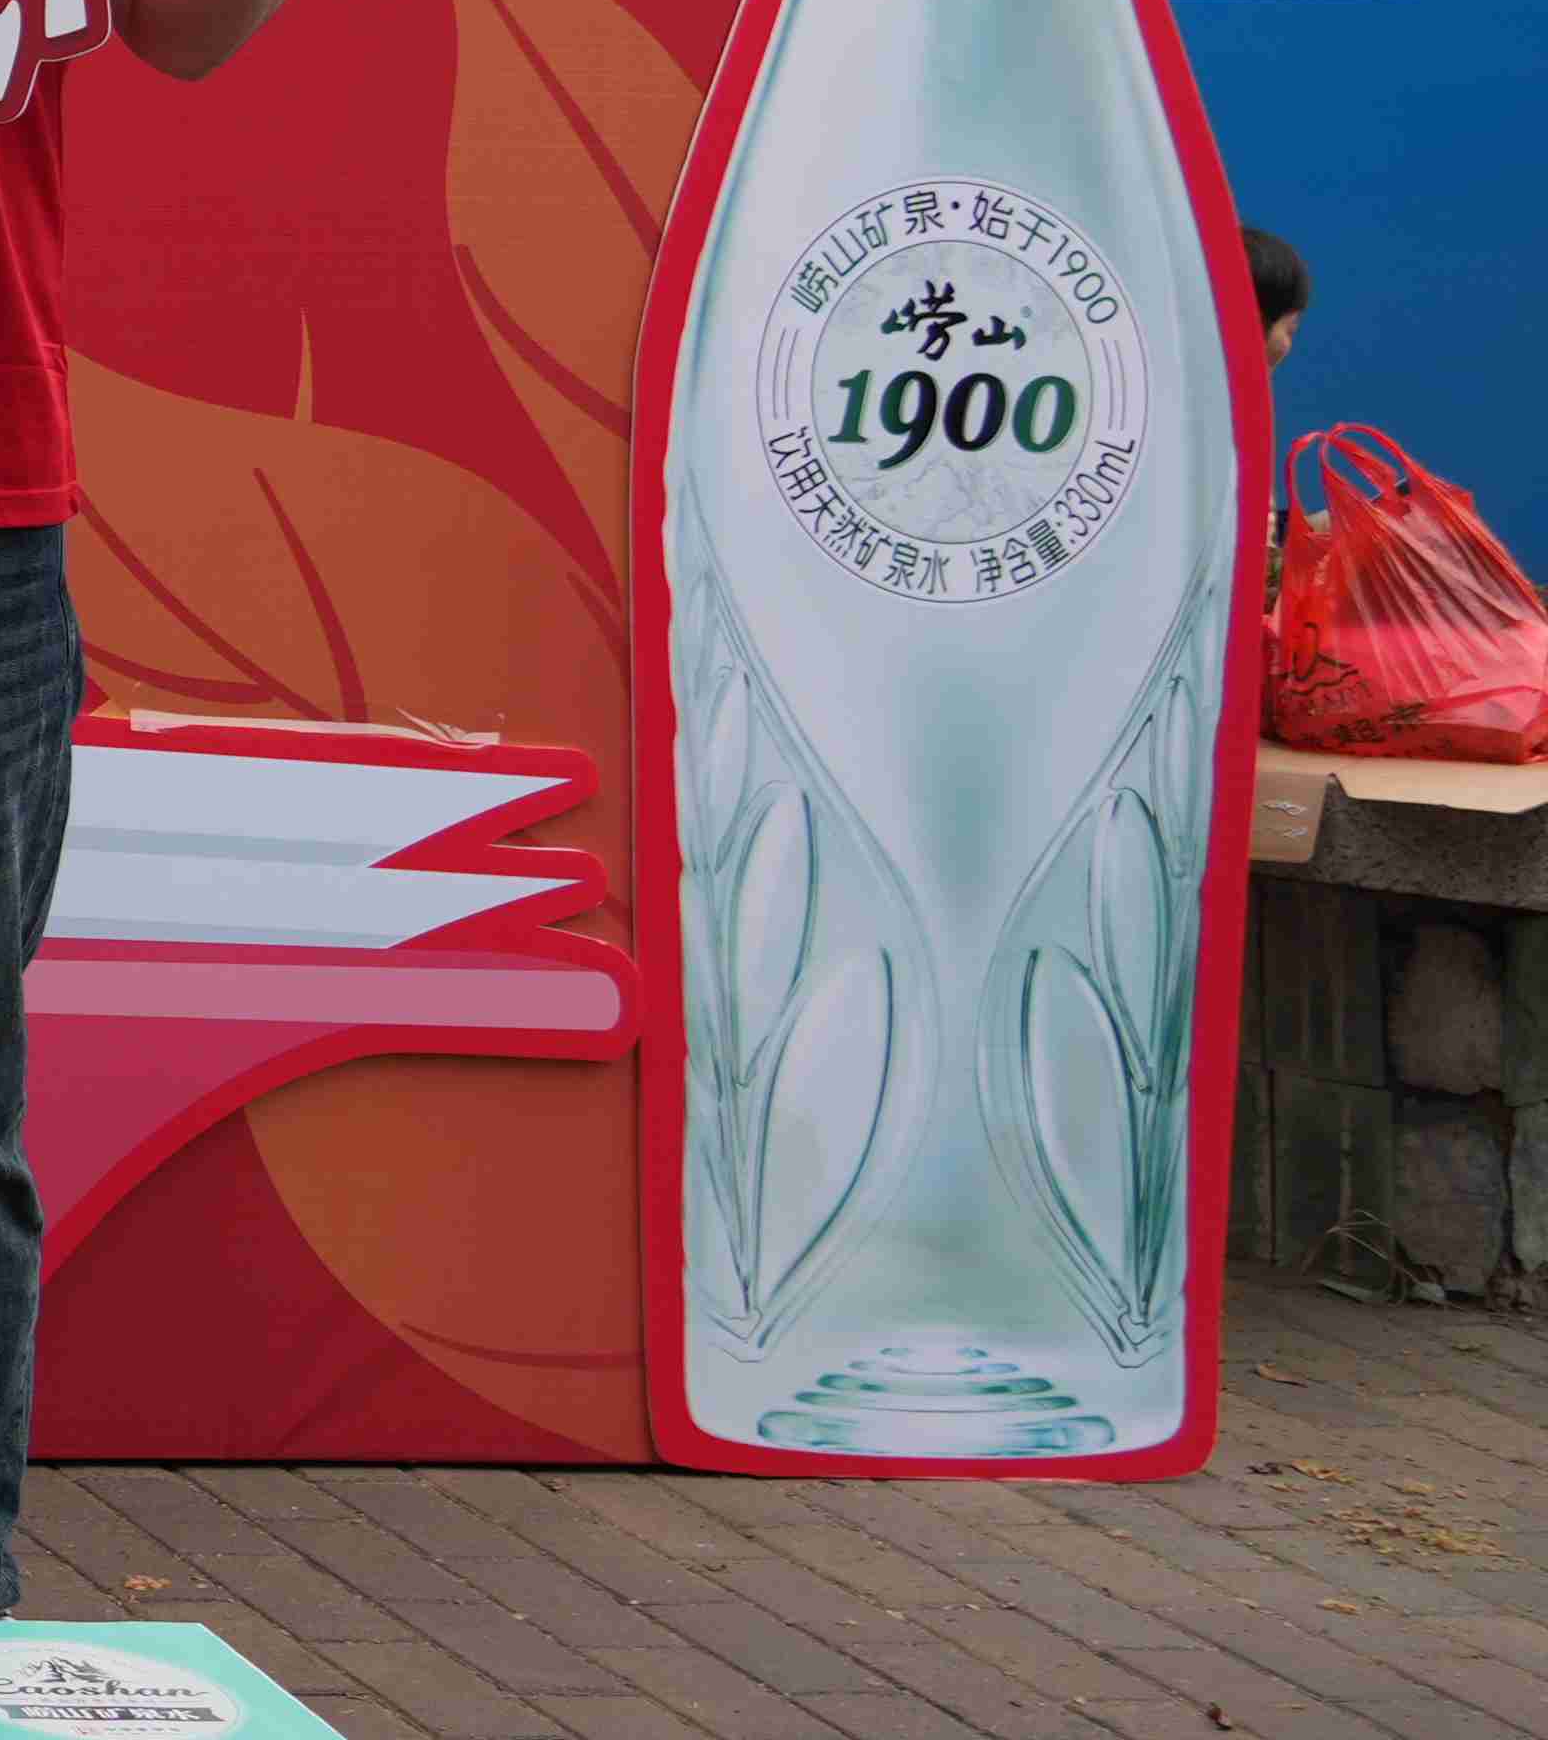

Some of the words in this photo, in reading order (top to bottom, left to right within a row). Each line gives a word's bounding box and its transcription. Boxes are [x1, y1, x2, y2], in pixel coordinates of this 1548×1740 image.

[790, 190, 1119, 326] 崂山矿泉·始于1900
[880, 280, 1026, 361] 崂山
[827, 369, 1077, 471] 1900
[769, 426, 951, 595] 饮用天然矿泉水
[969, 438, 1135, 594] 净含量:330mL
